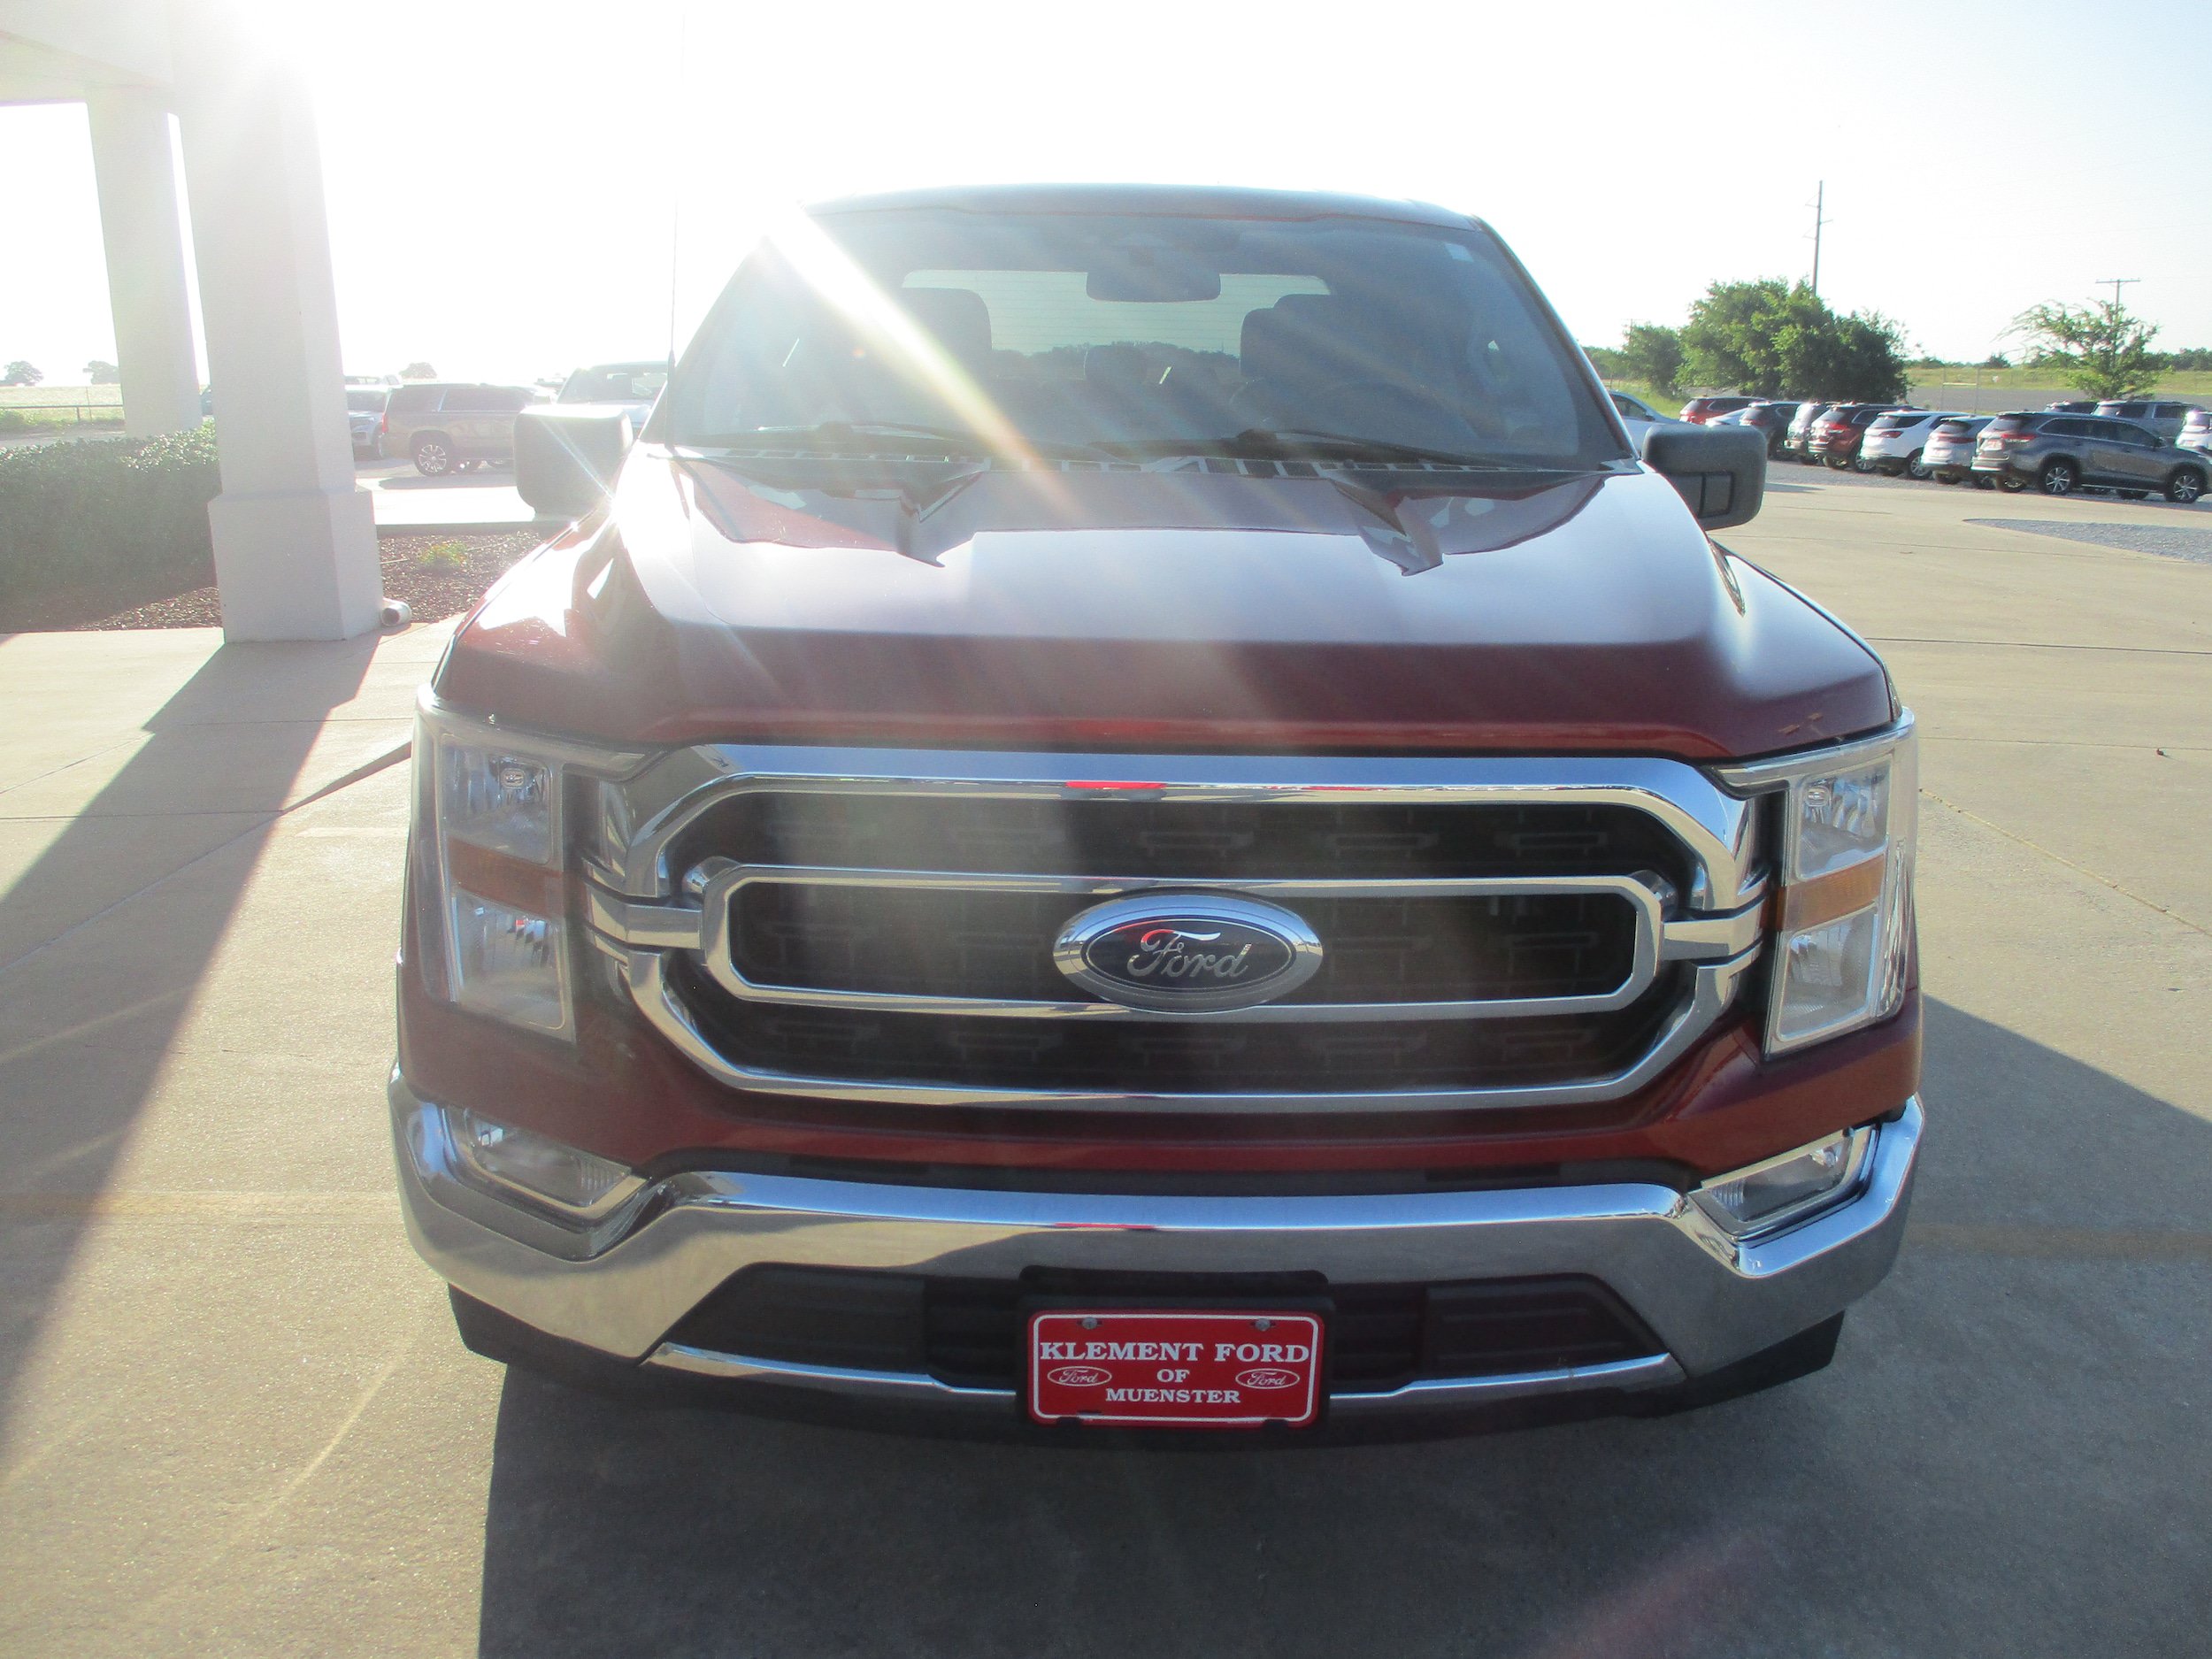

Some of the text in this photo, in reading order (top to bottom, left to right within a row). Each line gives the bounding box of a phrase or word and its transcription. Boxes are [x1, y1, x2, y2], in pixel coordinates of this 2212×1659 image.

[1126, 929, 1252, 977] Ford
[1040, 1342, 1310, 1363] KLEMENT FORD
[1058, 1370, 1100, 1385] Ford
[1156, 1369, 1190, 1383] OF
[1247, 1371, 1288, 1387] Ford
[1105, 1388, 1241, 1404] MUENSTER
